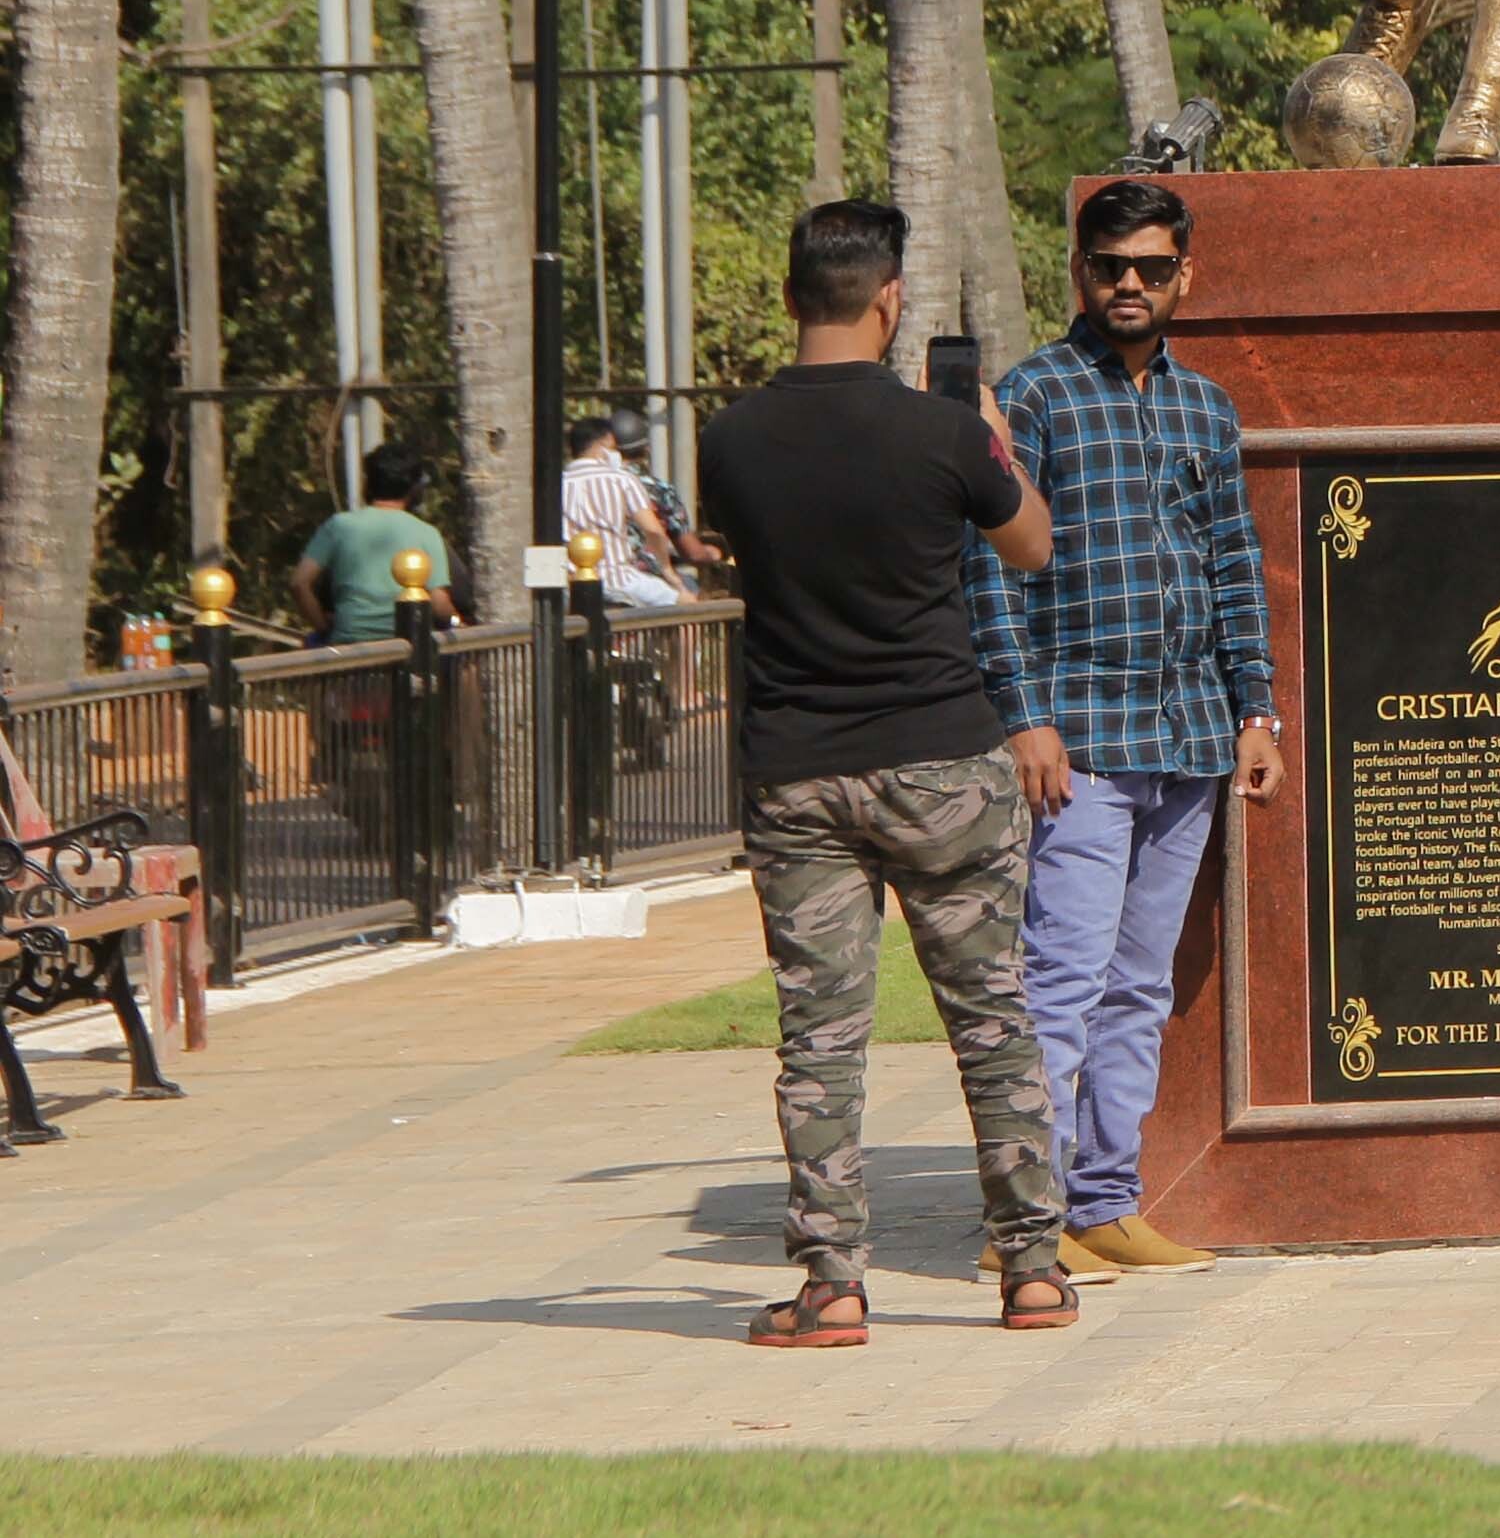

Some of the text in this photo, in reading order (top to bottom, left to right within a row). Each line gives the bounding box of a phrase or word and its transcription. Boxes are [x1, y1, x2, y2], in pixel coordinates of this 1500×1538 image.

[1353, 740, 1380, 752] Born
[1384, 740, 1394, 751] in
[1398, 738, 1445, 751] Madeira
[1448, 740, 1464, 749] on
[1468, 737, 1486, 749] the
[1353, 754, 1422, 770] professional
[1424, 752, 1482, 765] footballer.
[1354, 771, 1368, 782] he
[1374, 770, 1392, 782] set
[1398, 769, 1439, 781] himself
[1445, 771, 1460, 779] on
[1467, 770, 1482, 779] an
[1354, 784, 1414, 797] dedication
[1416, 784, 1438, 795] and
[1441, 783, 1467, 794] hard
[1354, 800, 1394, 815] players
[1397, 802, 1423, 811] ever
[1425, 799, 1437, 810] to
[1440, 798, 1468, 810] have
[1354, 816, 1373, 827] the
[1377, 814, 1424, 830] Portugal
[1428, 813, 1456, 825] team
[1460, 813, 1472, 824] to
[1475, 812, 1494, 823] the
[1355, 830, 1388, 842] broke
[1392, 830, 1410, 841] the
[1414, 828, 1448, 840] iconic
[1451, 827, 1486, 839] World
[1356, 844, 1417, 860] footballing
[1420, 843, 1461, 858] history.
[1464, 842, 1486, 854] The
[1355, 861, 1372, 872] his
[1374, 859, 1420, 872] national
[1458, 857, 1480, 869] also
[1378, 875, 1404, 886] Real
[1407, 873, 1449, 886] Madrid
[1453, 873, 1465, 884] &
[1356, 889, 1416, 905] inspiration
[1419, 889, 1436, 900] for
[1440, 887, 1483, 900] millions
[1486, 887, 1499, 898] of
[1356, 905, 1386, 920] great
[1390, 903, 1446, 916] footballer
[1449, 903, 1464, 914] he
[1468, 902, 1477, 914] is
[1429, 970, 1475, 989] MR.
[1396, 1025, 1440, 1045] FOR
[1444, 1023, 1488, 1043] THE
